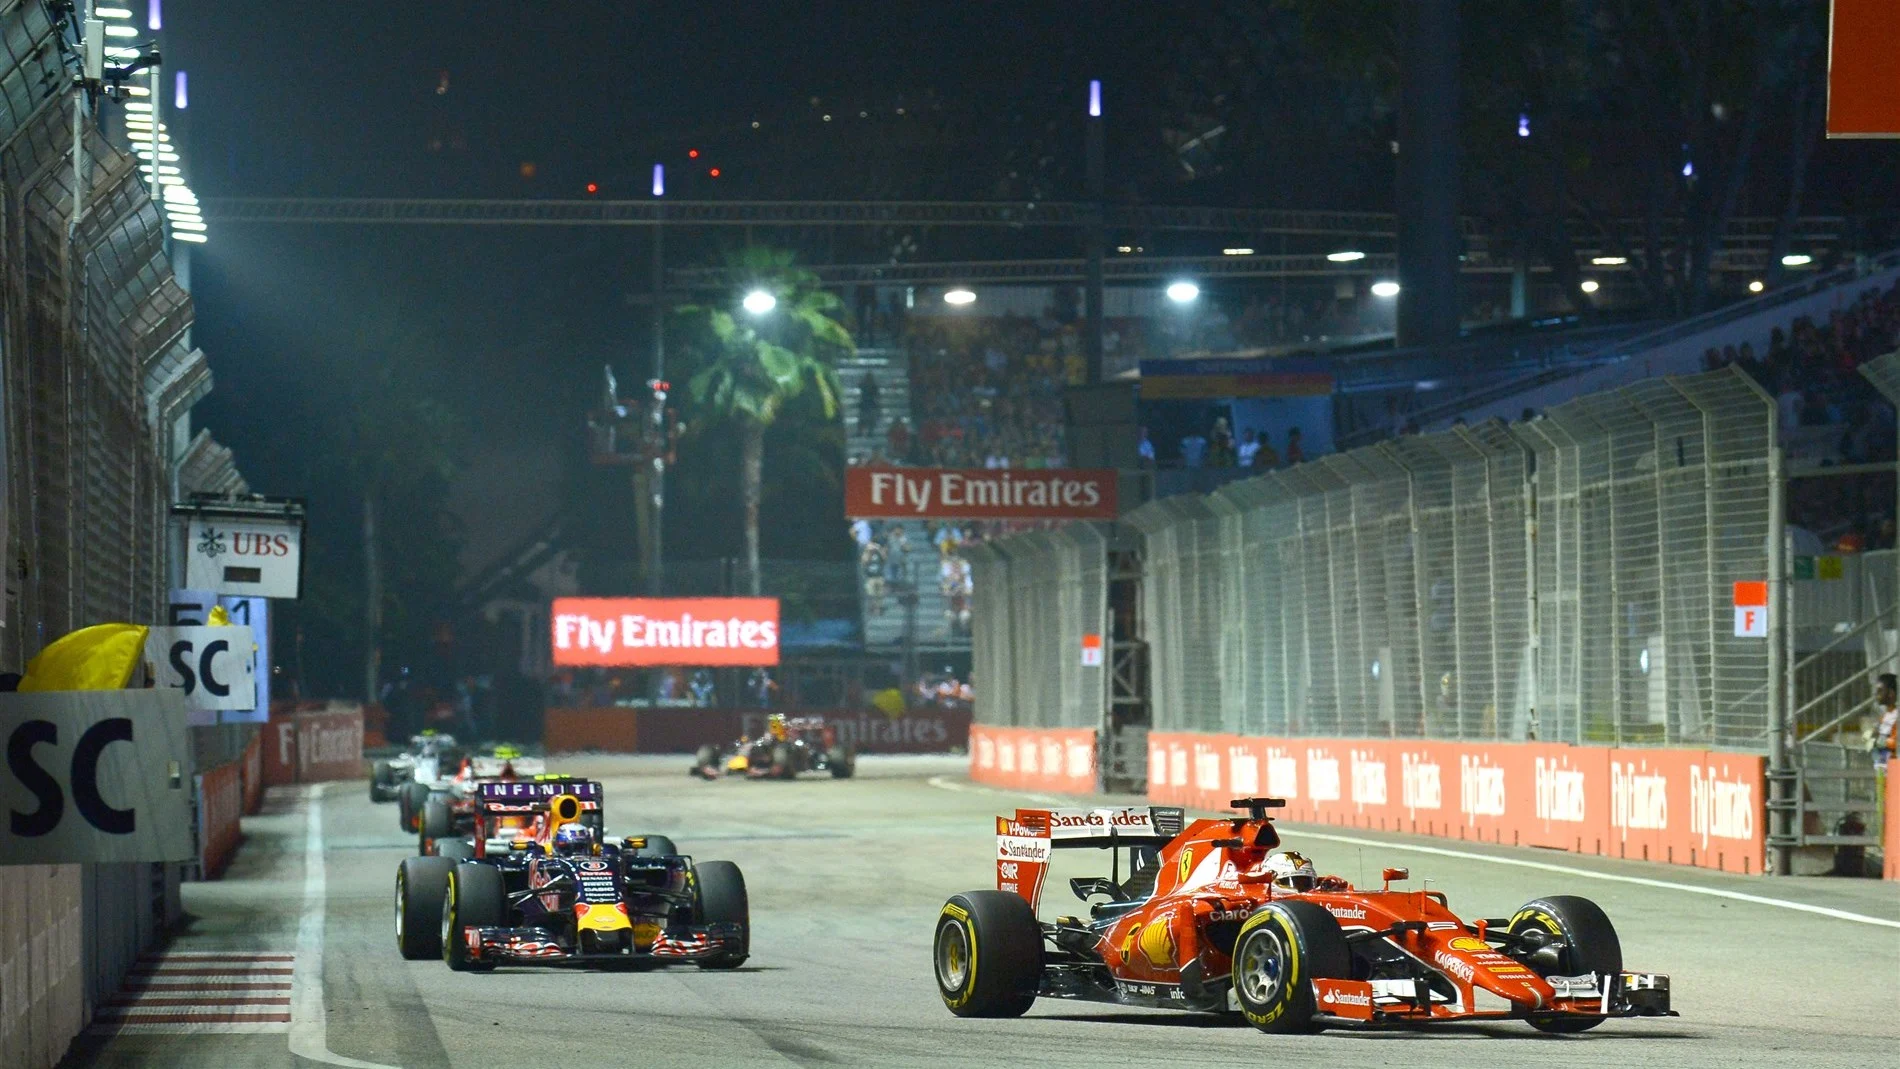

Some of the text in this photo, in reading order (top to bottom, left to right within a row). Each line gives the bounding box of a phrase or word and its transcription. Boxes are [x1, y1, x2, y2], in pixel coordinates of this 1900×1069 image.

[871, 472, 1101, 511] Fly Emirates
[233, 532, 289, 557] UBS
[555, 612, 777, 653] Fly Emirates
[1744, 611, 1755, 632] F
[169, 640, 230, 697] SC
[6, 717, 136, 838] SC
[483, 783, 596, 796] INFINITI
[1007, 840, 1046, 859] Santander
[1325, 902, 1367, 920] Santander
[1333, 988, 1371, 1007] Santander
